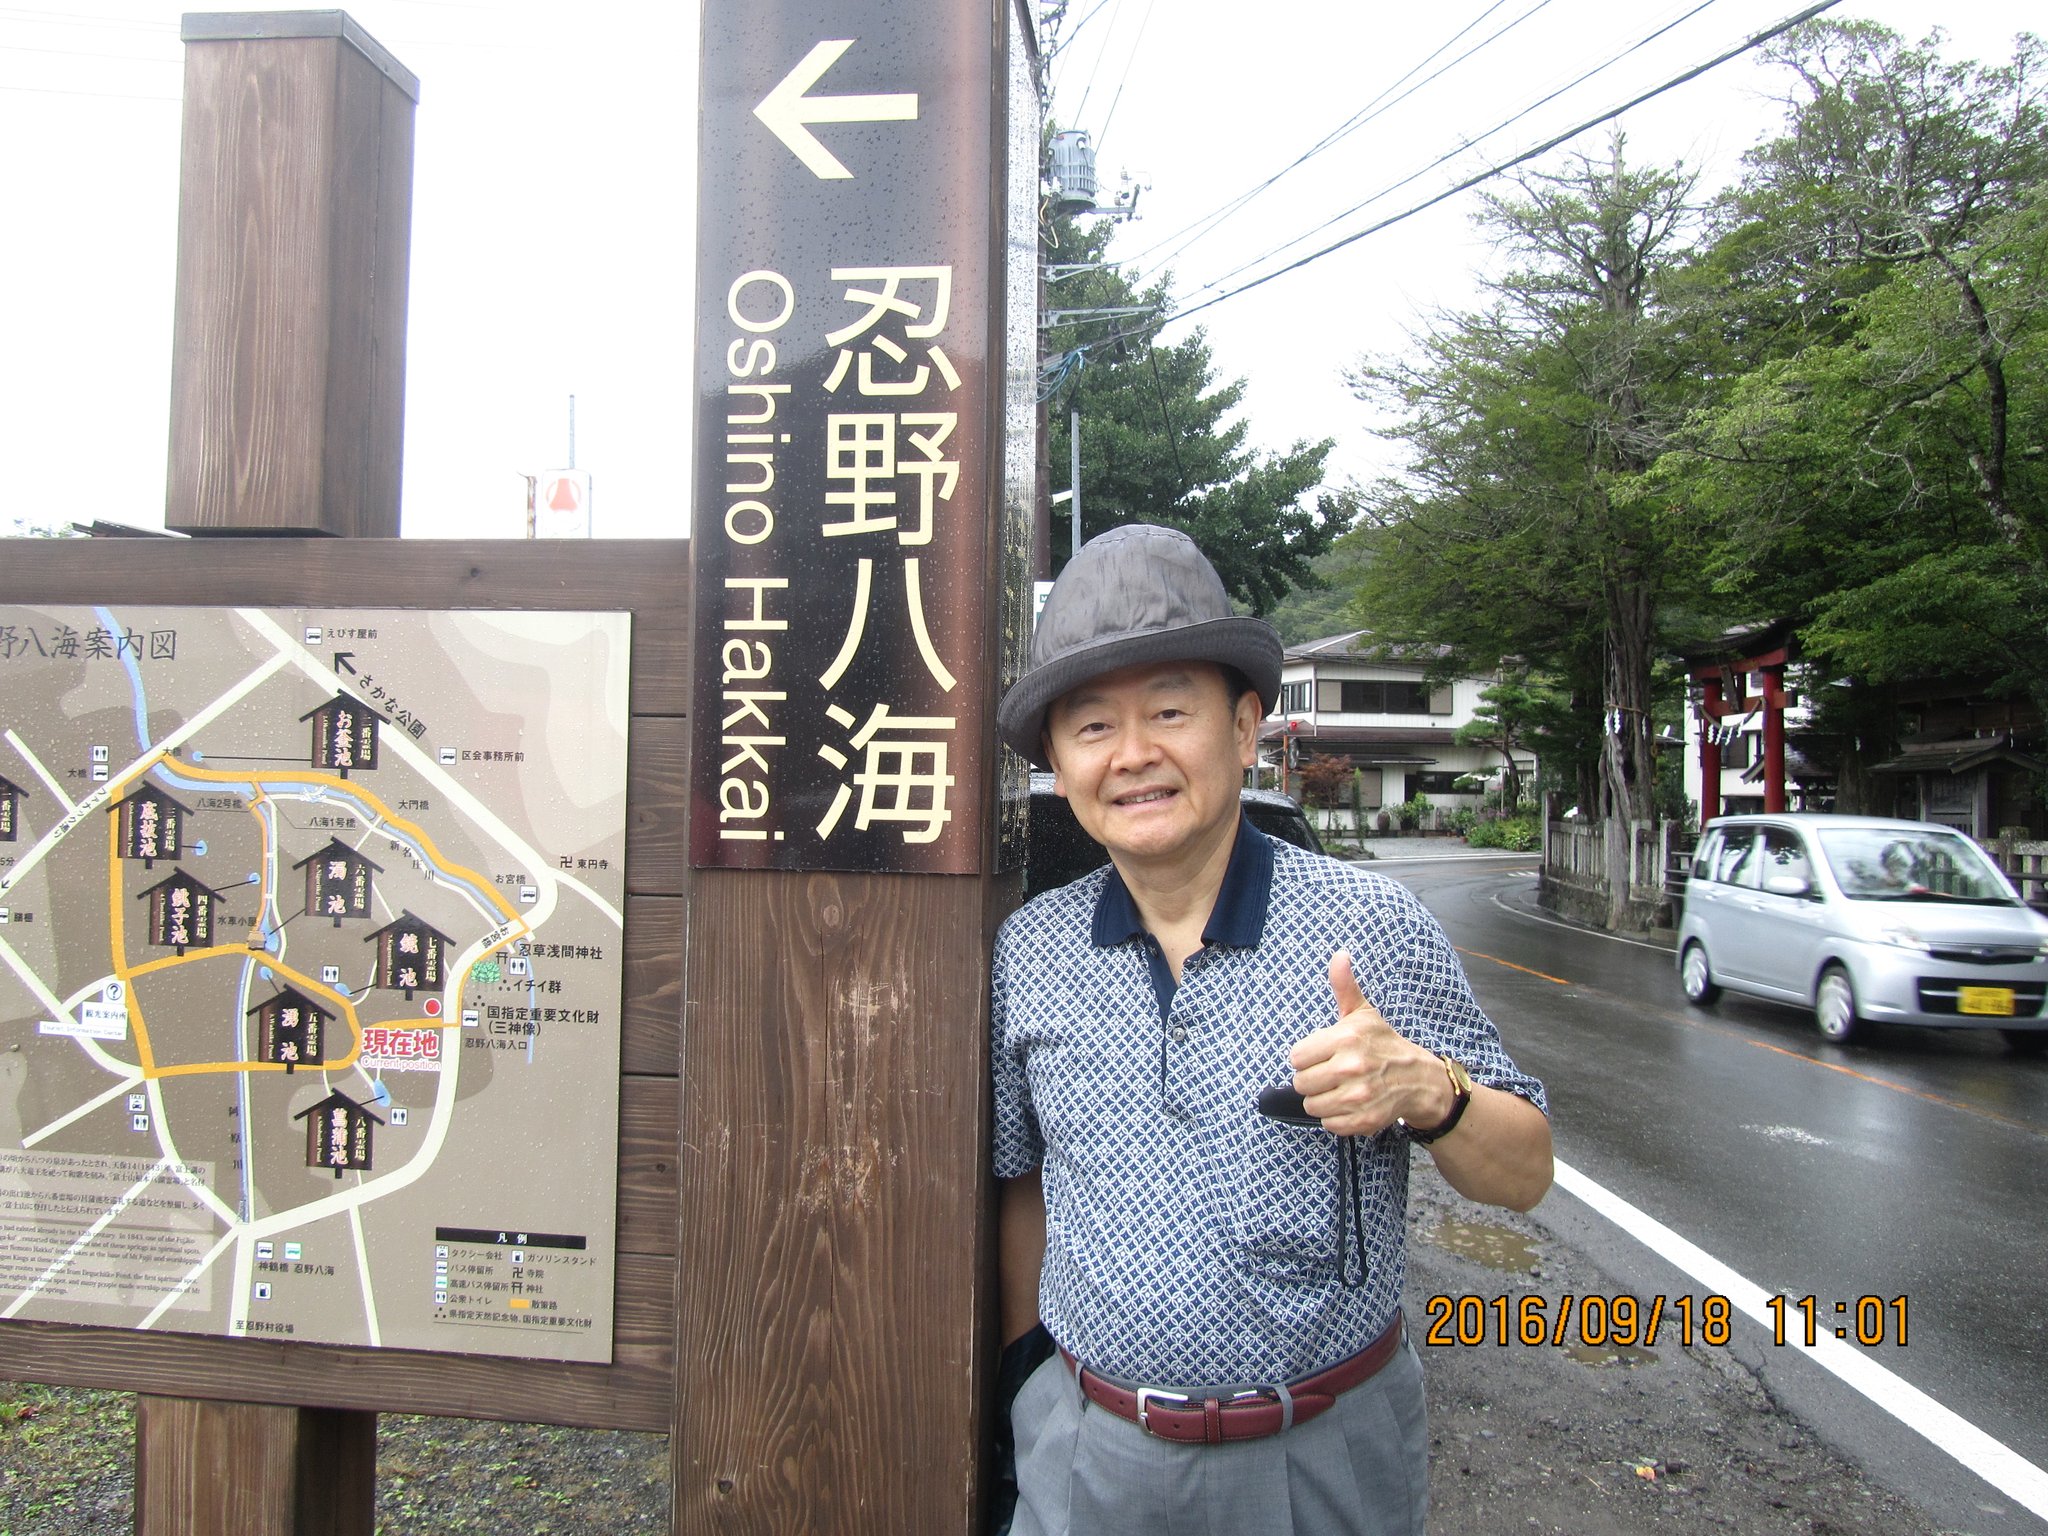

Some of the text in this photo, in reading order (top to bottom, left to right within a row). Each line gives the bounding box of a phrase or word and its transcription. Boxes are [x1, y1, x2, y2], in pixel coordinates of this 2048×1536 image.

[719, 269, 796, 841] Oshino Hakkai
[814, 265, 962, 844] 忍野八海
[327, 629, 377, 640] えびす屋前
[359, 675, 427, 739] さかな公園
[335, 710, 353, 767] お釜池
[462, 750, 525, 762] 区会事務所前
[197, 799, 242, 809] 八海2号橋
[398, 800, 429, 811] 大門橋
[309, 817, 356, 828] 八海1号橋
[577, 858, 609, 870] 東円寺
[496, 874, 526, 885] お宮橋
[519, 943, 603, 960] 忍草浅間神社
[514, 979, 562, 993] イチイ群
[86, 1009, 126, 1019] 観光案内所
[487, 1006, 599, 1024] 国指定重要文化財
[488, 1020, 541, 1036] (三神像)
[363, 1029, 439, 1057] 現在地
[465, 1037, 528, 1050] 忍野八海入口
[361, 1057, 441, 1072] Current position
[497, 1232, 528, 1245] 凡例
[451, 1249, 503, 1261] タクシー会社
[527, 1253, 597, 1266] ガソリンスタンド
[294, 1263, 335, 1276] 忍野八海
[450, 1264, 494, 1275] バス停留所
[526, 1269, 545, 1279] 寺院
[450, 1279, 509, 1291] 高速バス停留所
[527, 1284, 544, 1294] 神社
[449, 1294, 493, 1305] 公衆トイレ
[531, 1300, 558, 1310] 散策路
[235, 1319, 295, 1334] 至忍野村役場
